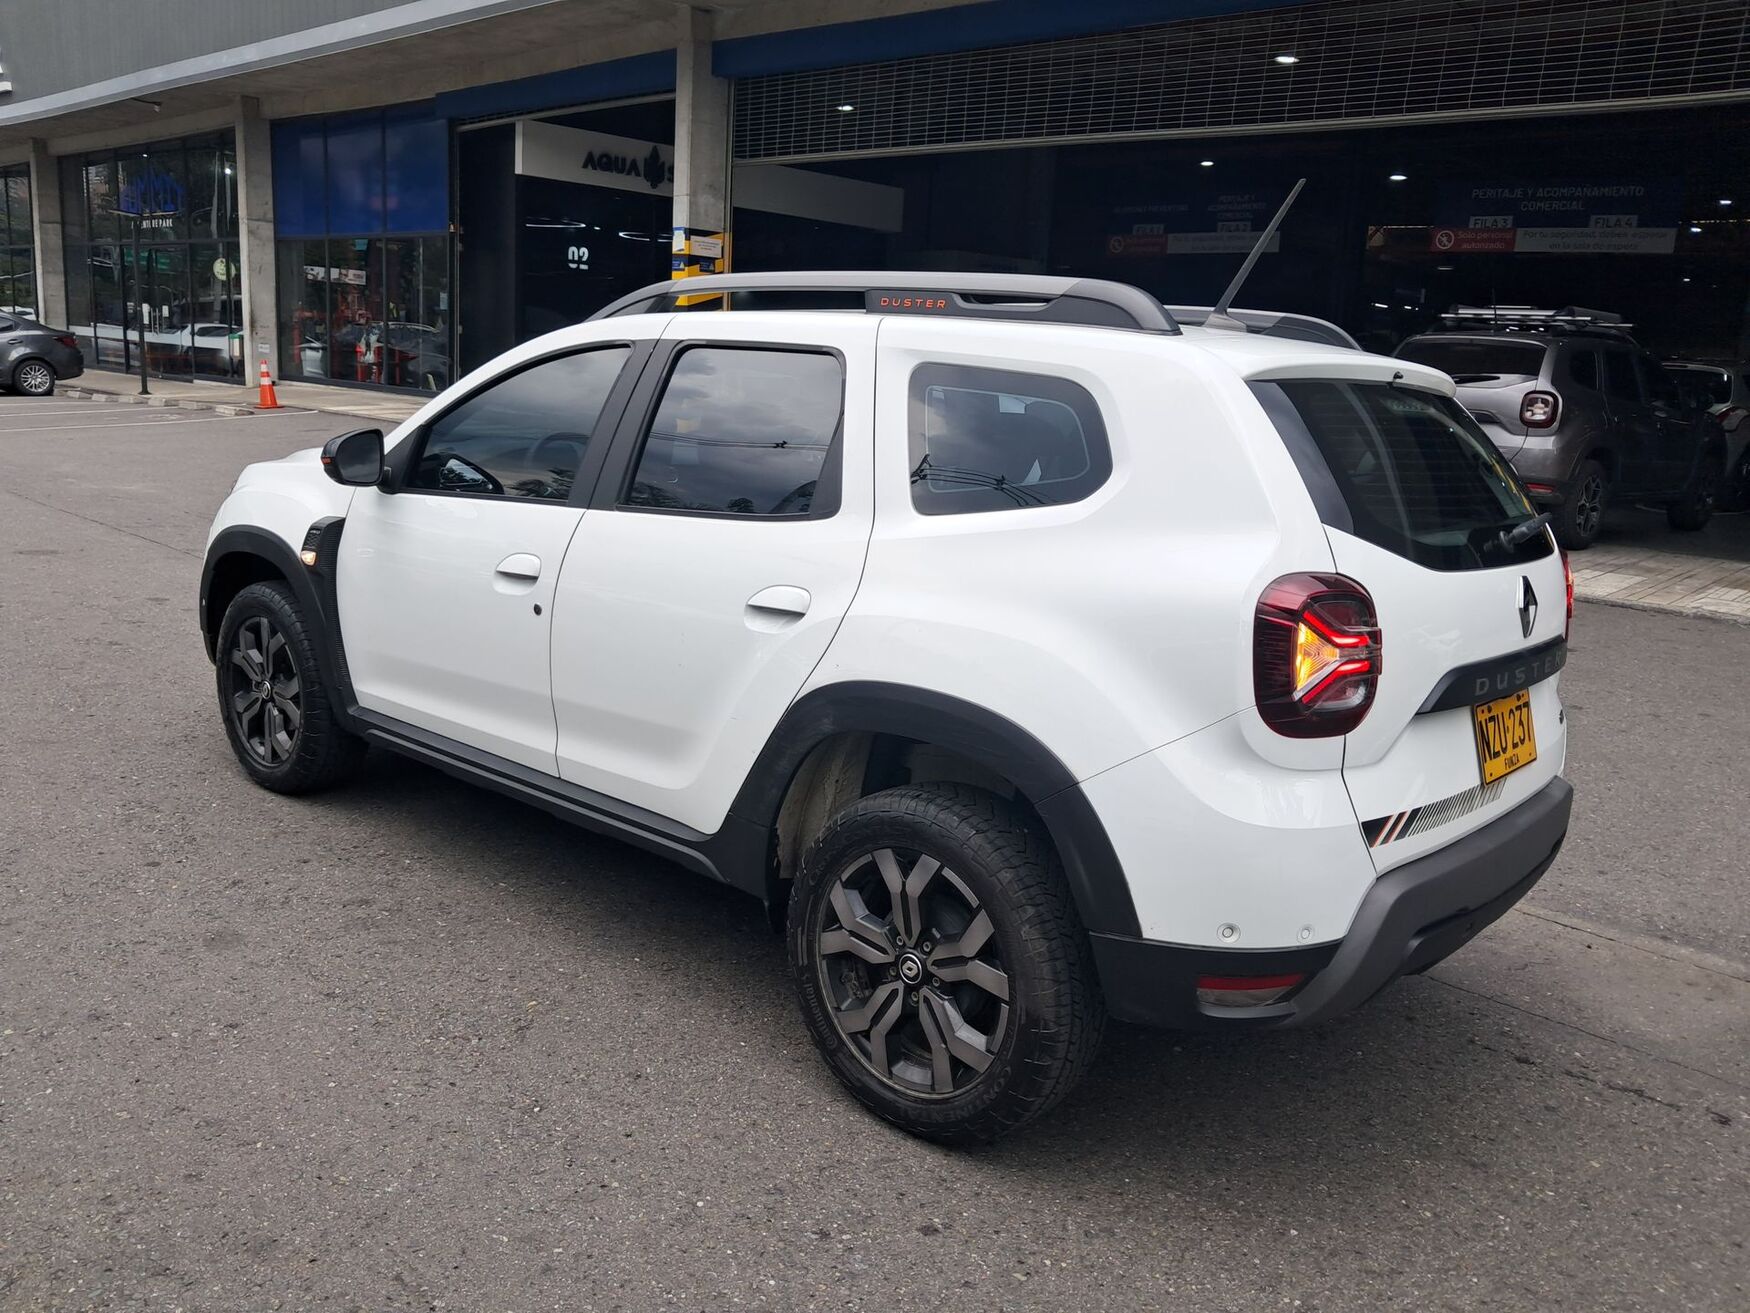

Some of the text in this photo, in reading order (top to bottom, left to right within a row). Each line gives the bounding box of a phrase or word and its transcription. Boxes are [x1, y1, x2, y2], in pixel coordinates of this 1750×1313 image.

[581, 151, 641, 177] AQUA
[1471, 187, 1524, 199] PERITAJE
[1527, 187, 1534, 198] Y
[1520, 200, 1585, 211] COMERCIAL
[1473, 218, 1509, 229] FILA 3
[1594, 217, 1633, 228] FILA 4
[567, 245, 589, 271] 02
[880, 297, 946, 309] DUSTER
[1475, 650, 1563, 697] DUSTER
[1504, 754, 1520, 771] FUNZA
